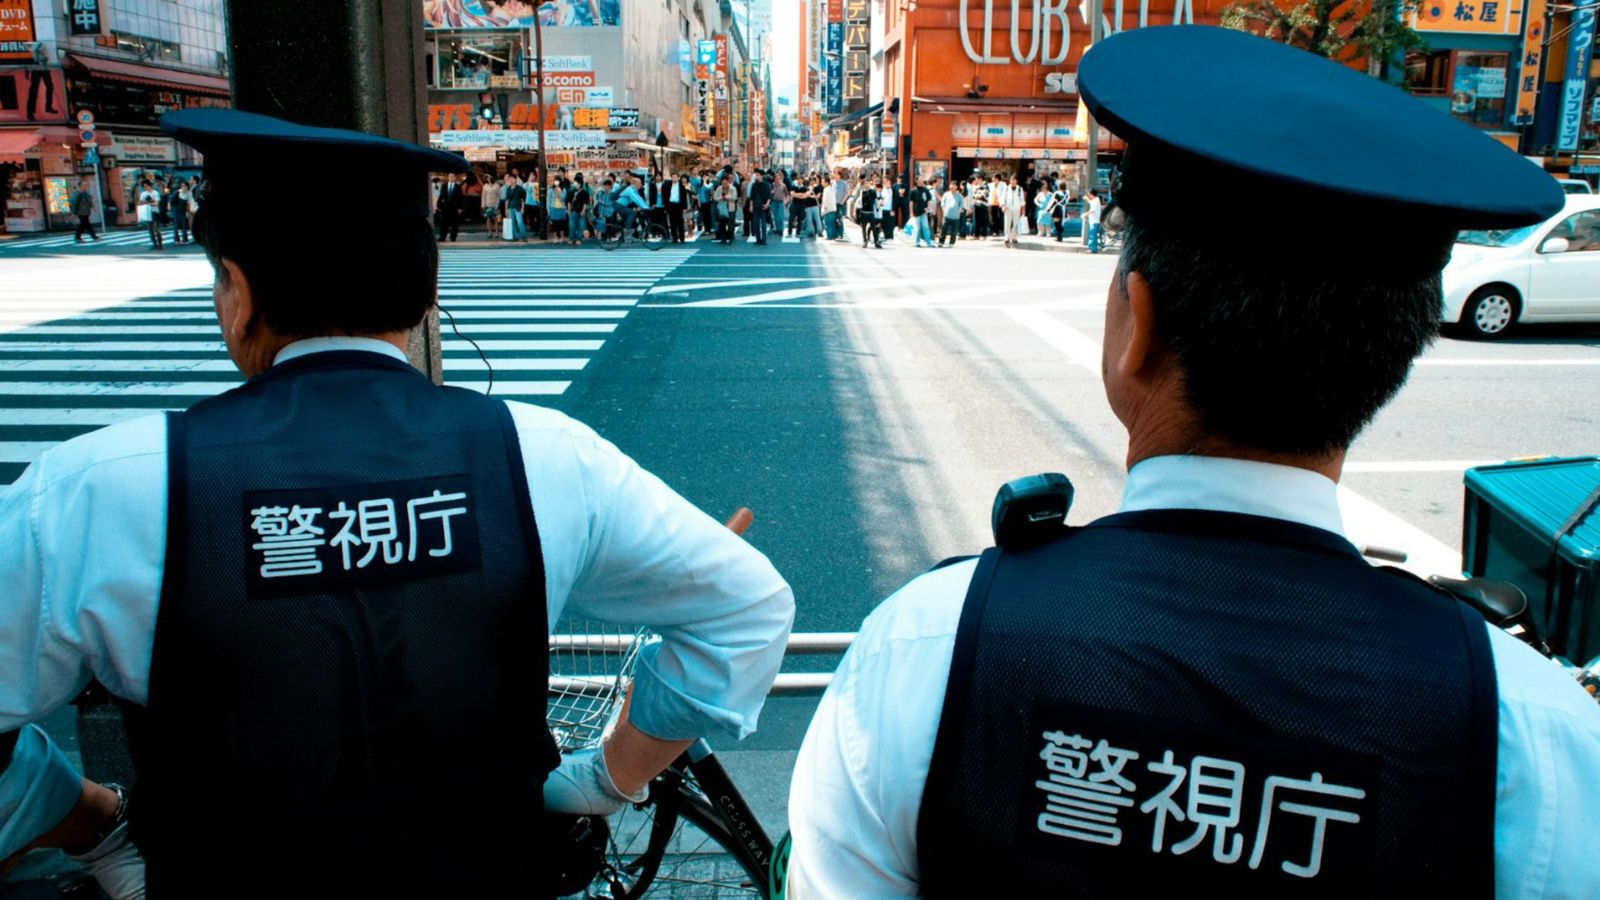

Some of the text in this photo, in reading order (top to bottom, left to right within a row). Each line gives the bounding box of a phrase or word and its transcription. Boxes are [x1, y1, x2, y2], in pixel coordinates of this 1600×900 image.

[1, 8, 26, 19] DVD
[1454, 1, 1498, 22] 松屋
[959, 0, 1071, 65] CLUB
[716, 39, 727, 67] KFC
[848, 1, 865, 97] デパート
[547, 57, 588, 69] SoftBank
[1523, 51, 1538, 92] 松屋
[455, 132, 492, 143] SoftBank
[506, 132, 540, 143] SoftBan
[560, 133, 602, 143] SoftBank
[250, 489, 467, 578] 警視庁
[1035, 730, 1366, 878] 警視庁
